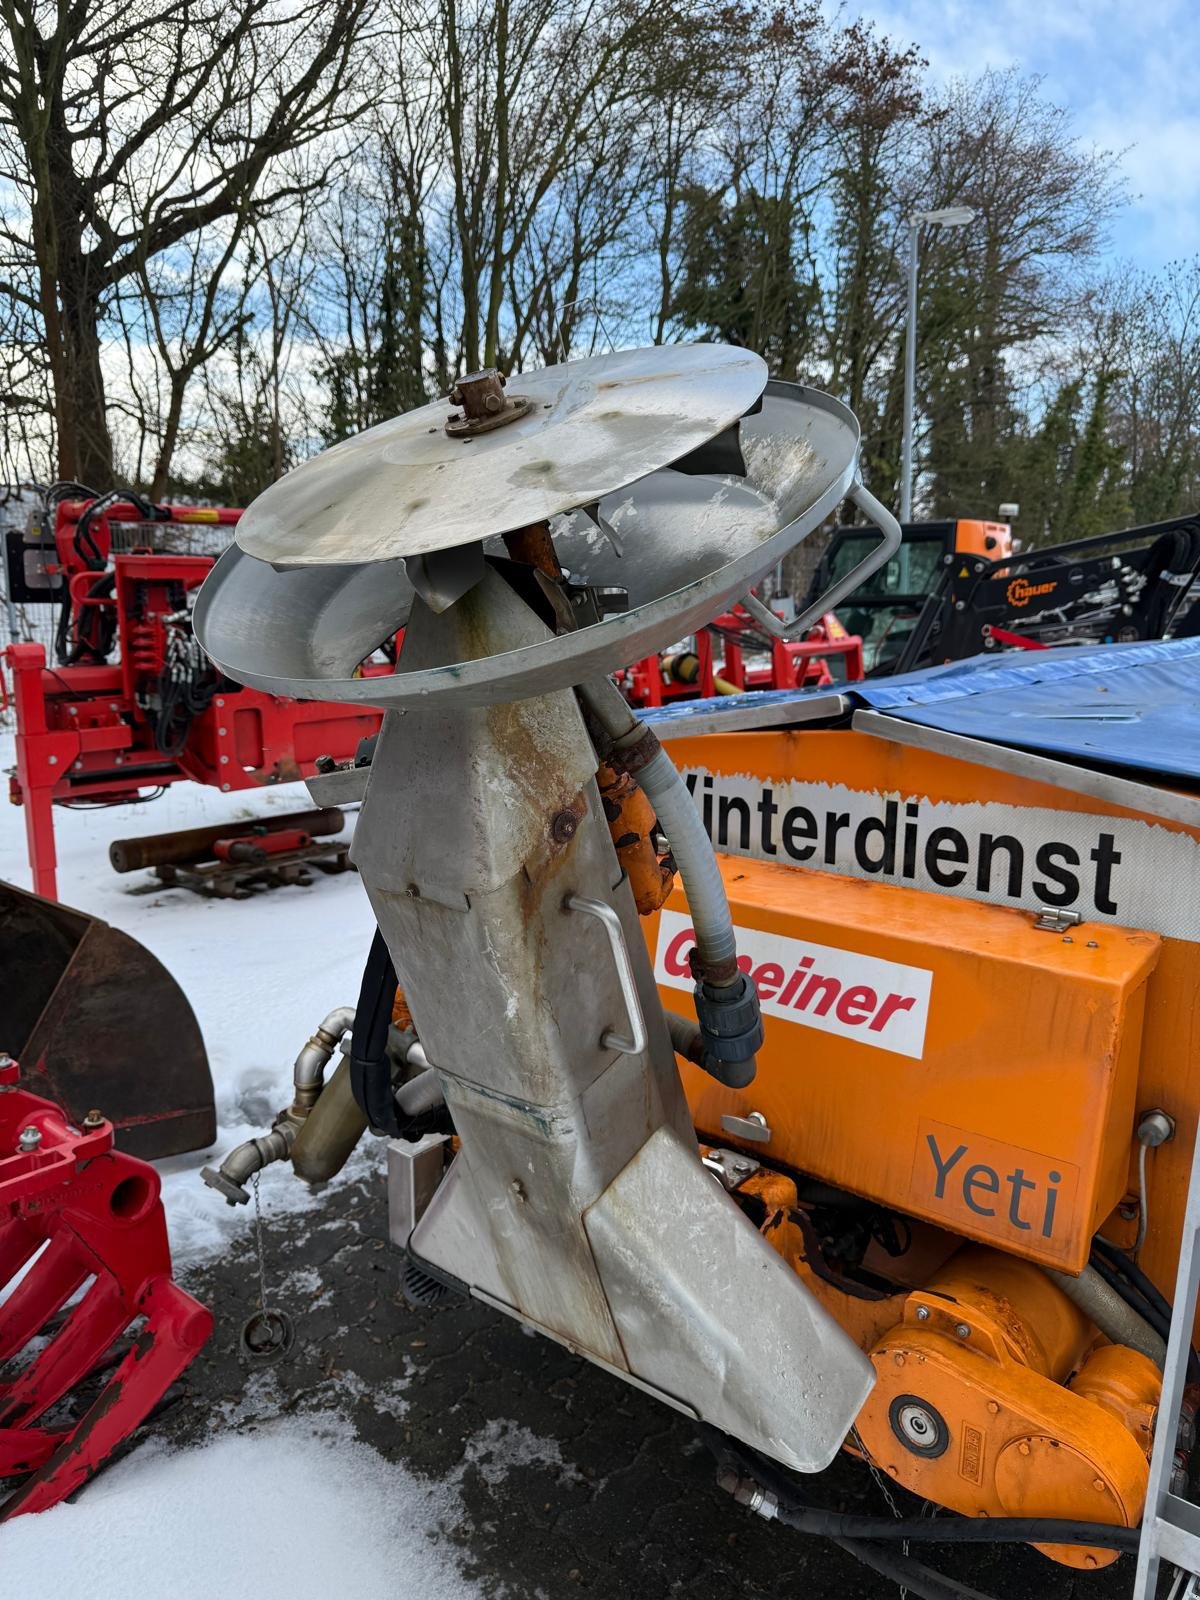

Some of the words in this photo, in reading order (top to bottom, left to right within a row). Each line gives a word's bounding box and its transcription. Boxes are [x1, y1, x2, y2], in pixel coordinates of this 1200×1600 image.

[686, 774, 1121, 915] interdienst
[664, 928, 917, 1032] Geiner
[926, 1134, 1062, 1238] Yeti
